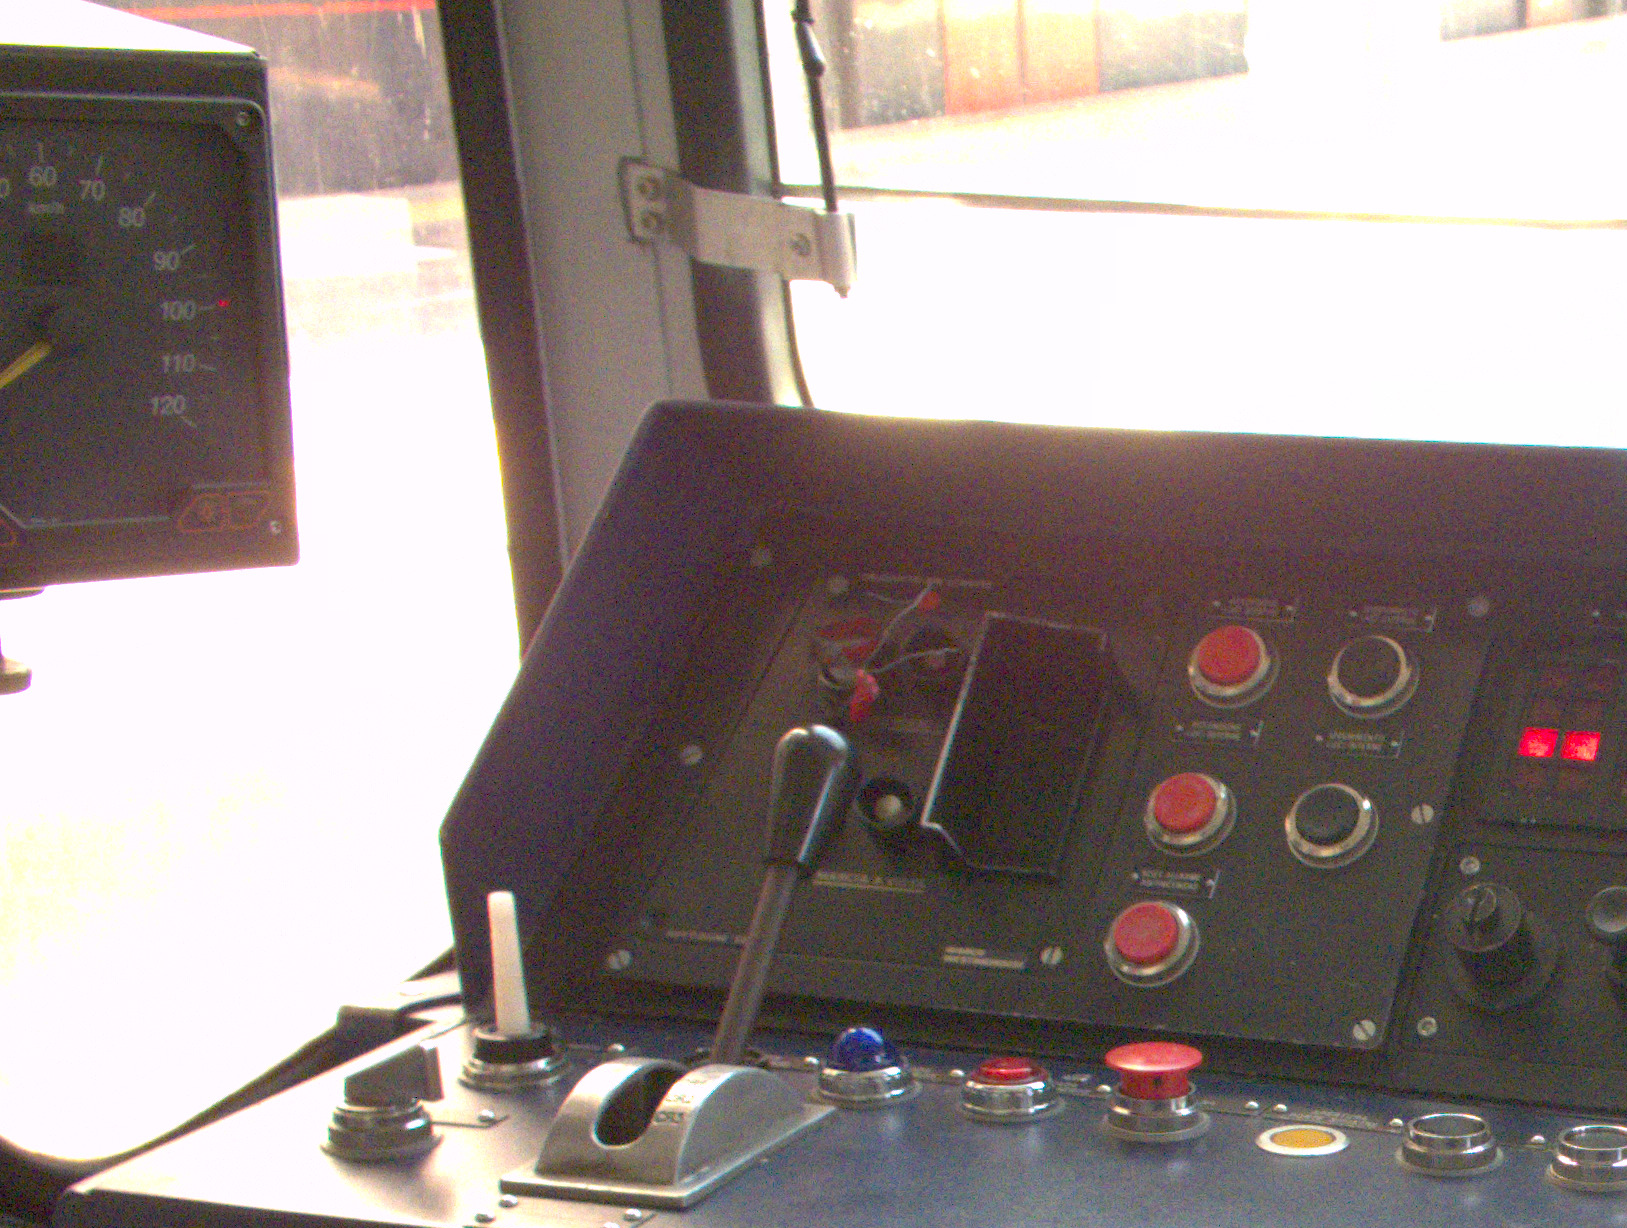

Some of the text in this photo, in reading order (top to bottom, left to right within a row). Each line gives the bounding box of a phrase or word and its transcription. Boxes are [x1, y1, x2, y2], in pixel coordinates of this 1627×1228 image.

[27, 166, 58, 187] 60
[79, 179, 106, 201] 70
[118, 207, 146, 228] 80
[154, 250, 180, 271] 90
[160, 300, 198, 321] 100
[162, 354, 196, 374] 110
[151, 394, 187, 416] 120
